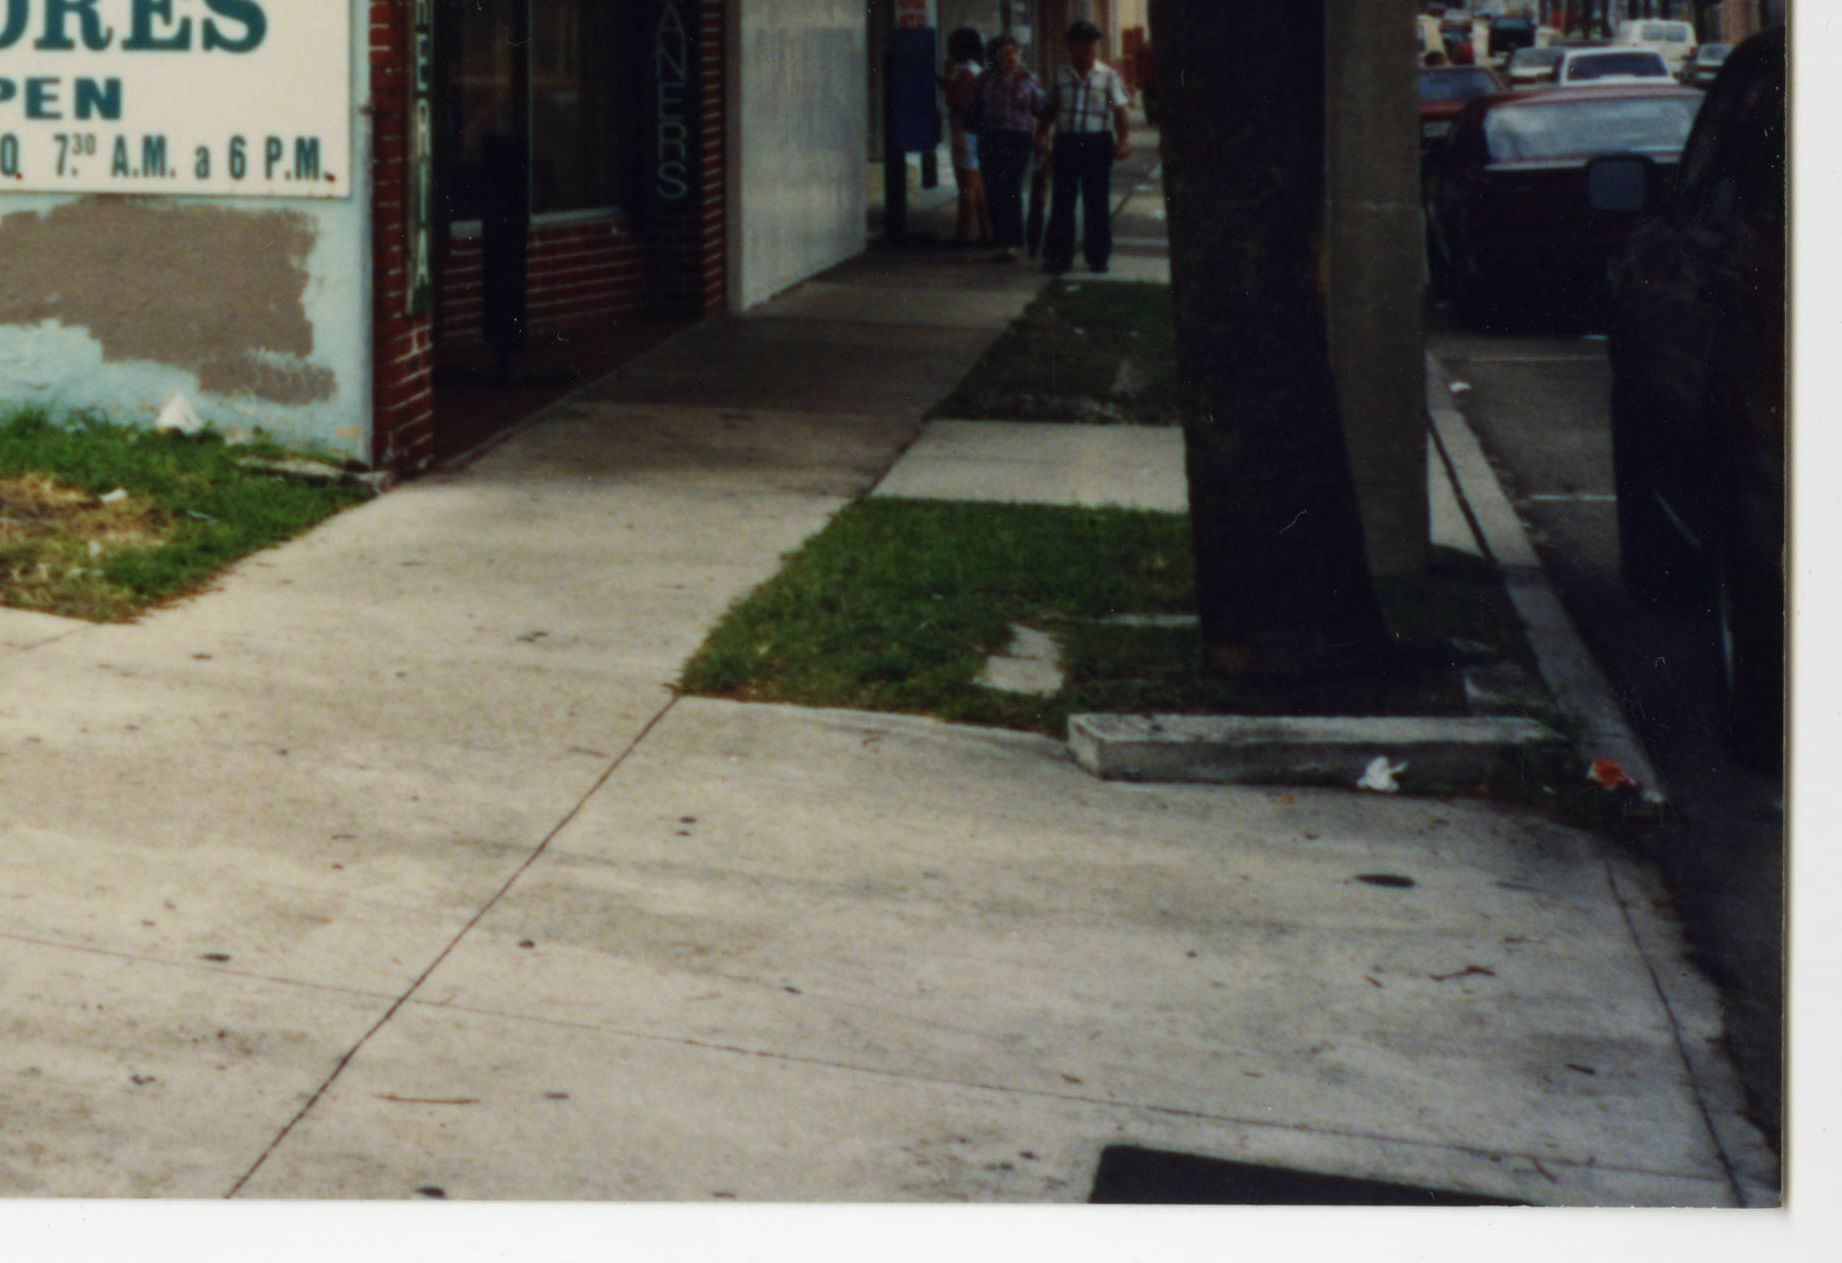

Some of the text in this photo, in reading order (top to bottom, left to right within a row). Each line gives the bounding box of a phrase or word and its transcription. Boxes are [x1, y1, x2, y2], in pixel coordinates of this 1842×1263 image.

[111, 133, 177, 179] A.M.
[194, 144, 211, 180] a
[228, 134, 247, 181] 6
[265, 134, 336, 182] P.M.
